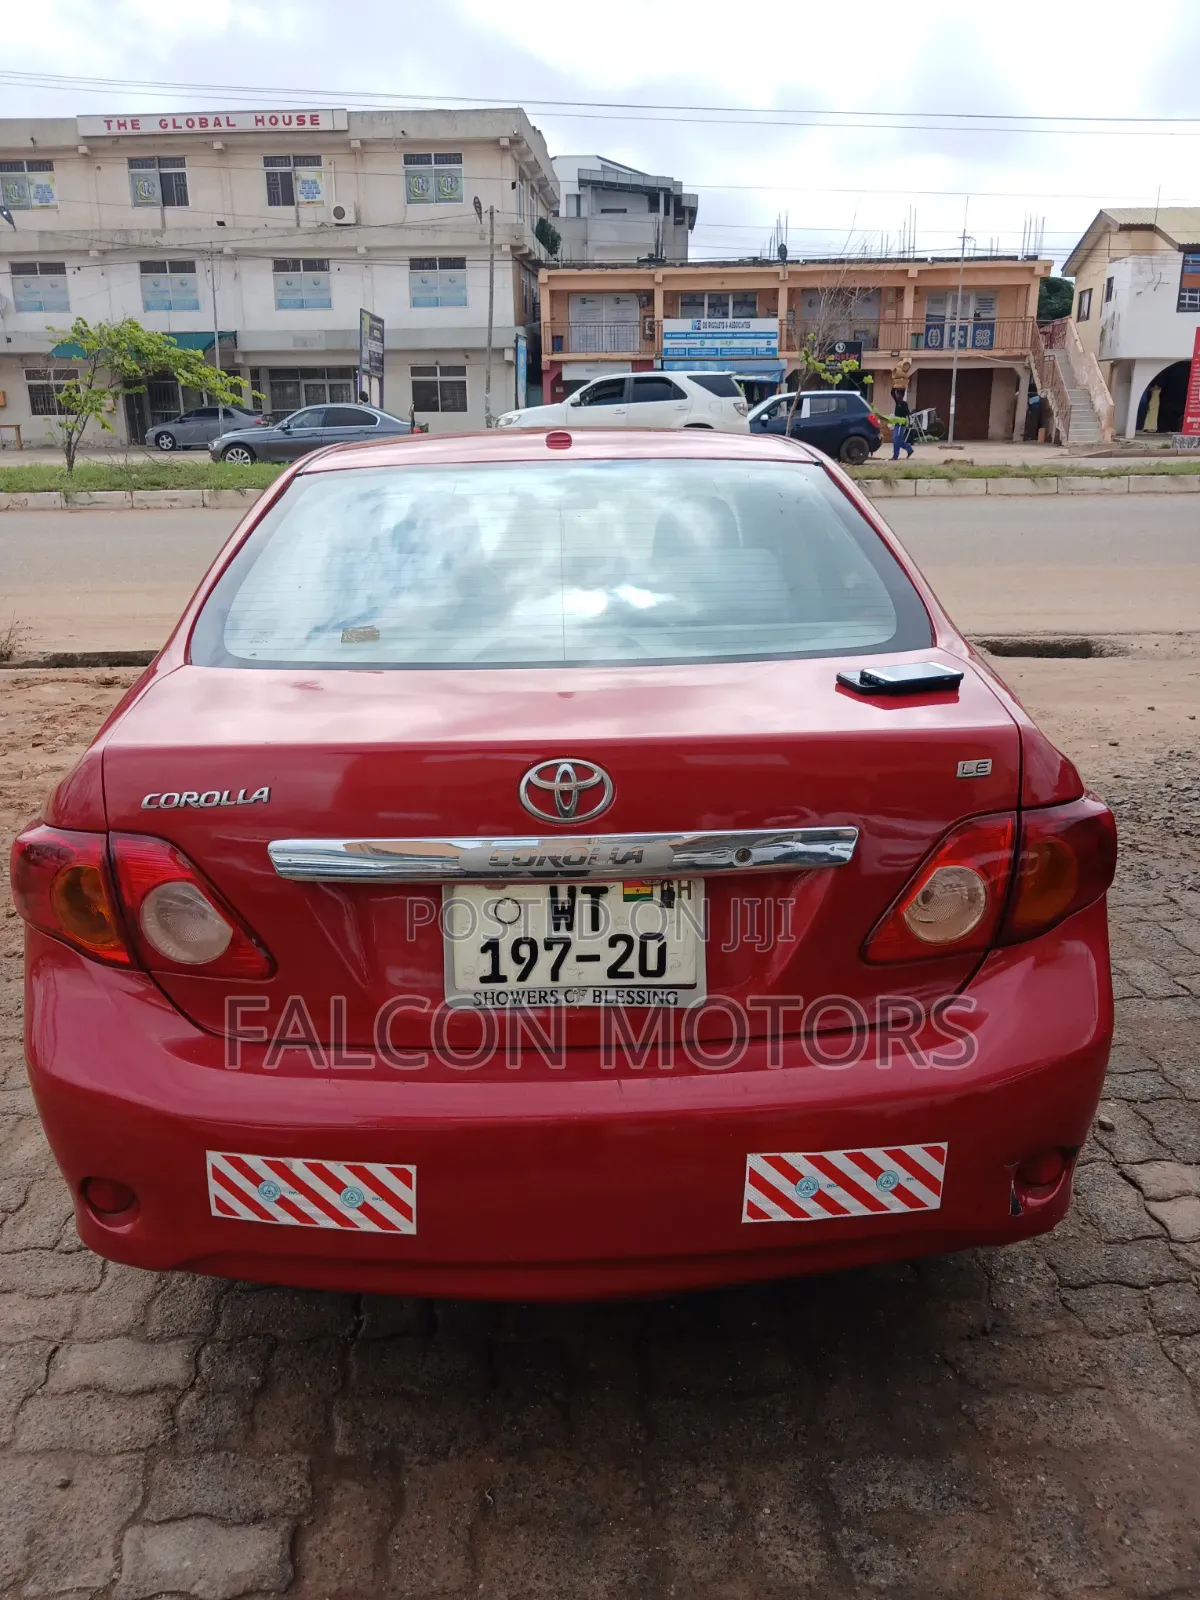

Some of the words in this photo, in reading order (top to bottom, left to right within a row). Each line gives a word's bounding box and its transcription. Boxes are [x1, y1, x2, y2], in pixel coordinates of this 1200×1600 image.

[104, 119, 141, 131] THE
[159, 115, 236, 130] GLOBAL
[254, 113, 320, 127] HOUSE
[962, 761, 989, 775] LE
[141, 786, 271, 809] COROLLA
[549, 885, 609, 931] WT
[479, 932, 667, 983] 197-20
[473, 990, 559, 1006] SHOWERS
[592, 989, 678, 1006] BLESSING
